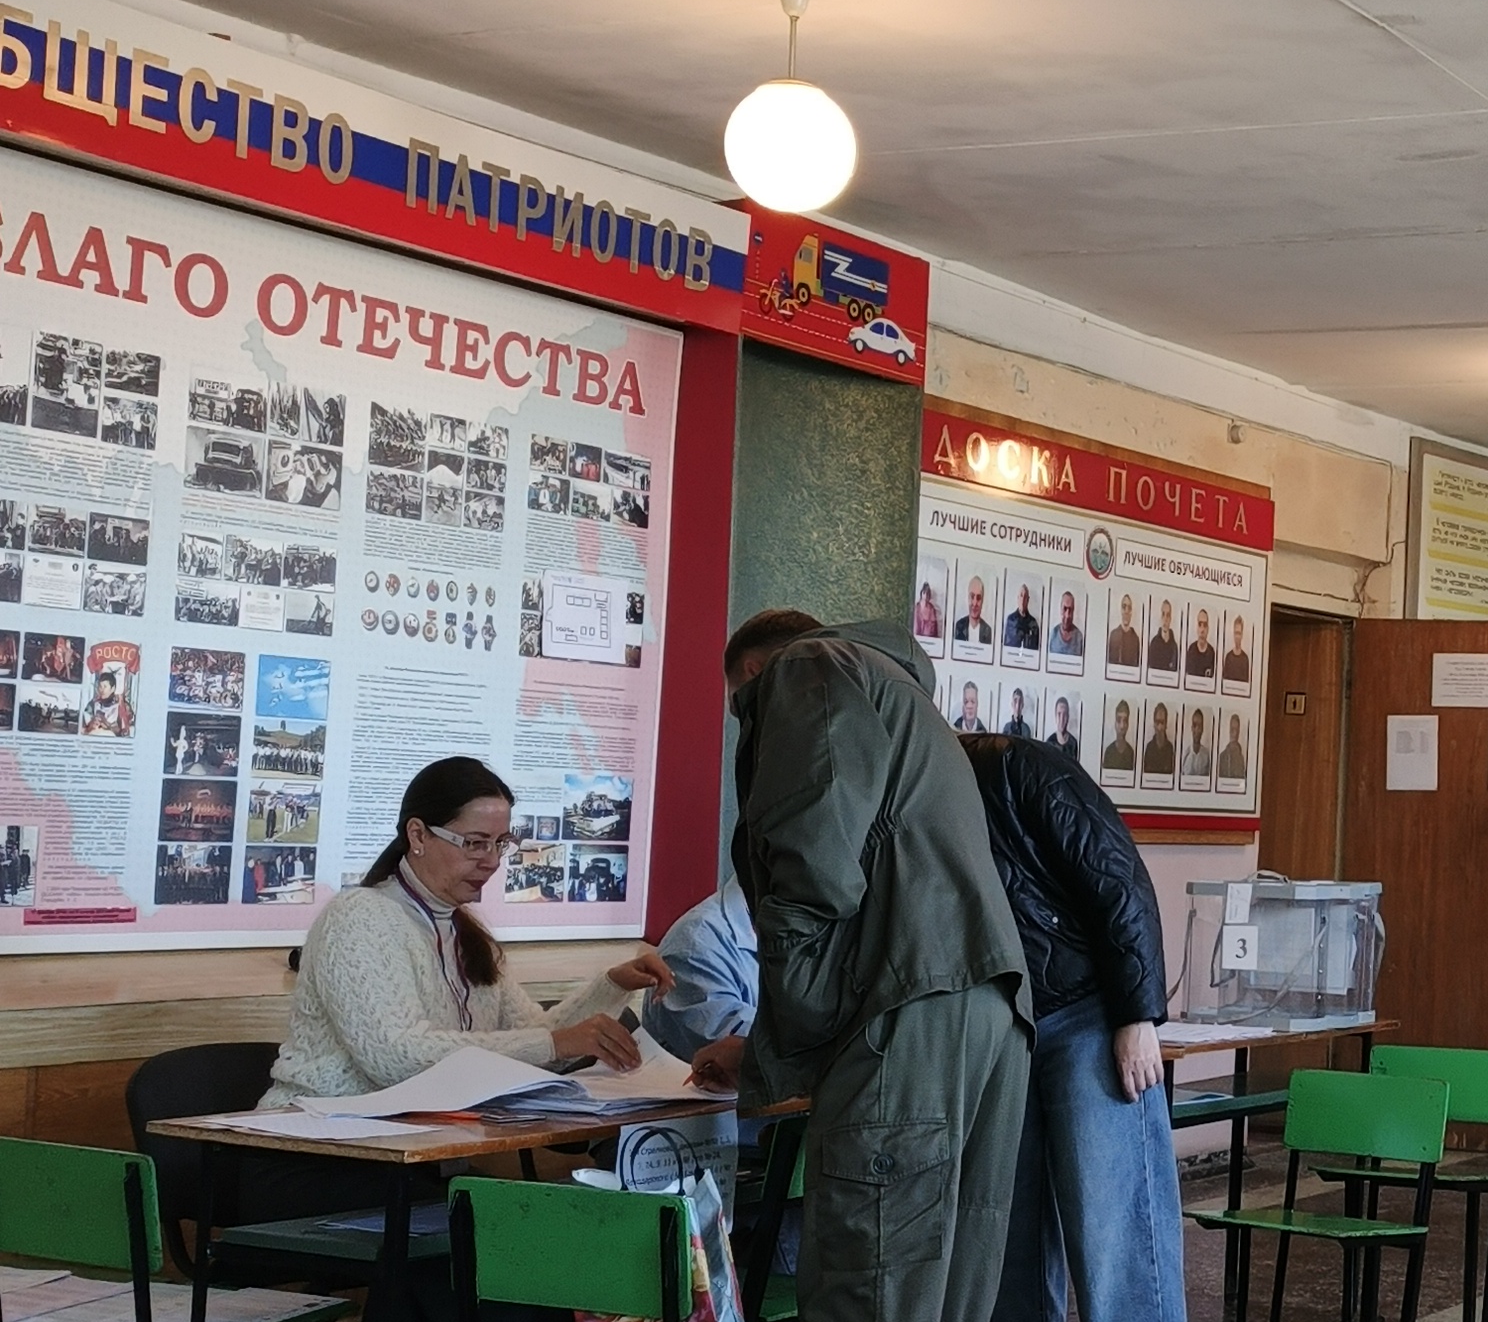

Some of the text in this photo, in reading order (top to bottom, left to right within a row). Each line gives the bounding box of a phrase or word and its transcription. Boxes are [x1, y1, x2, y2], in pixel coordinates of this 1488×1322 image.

[406, 137, 714, 292] ПАТРИОТОВ
[0, 204, 646, 416] ЛАГО ОТЕЧЕСТВА
[933, 424, 1249, 535] ДОСКА ПОЧЕТА
[930, 510, 1073, 553] ЛУЧШИЕ СОТРУДНИКИ
[1123, 551, 1244, 588] ЛУЧШИЕ ОБУЧАЮЩИЕСЯ
[1235, 938, 1248, 959] 3
